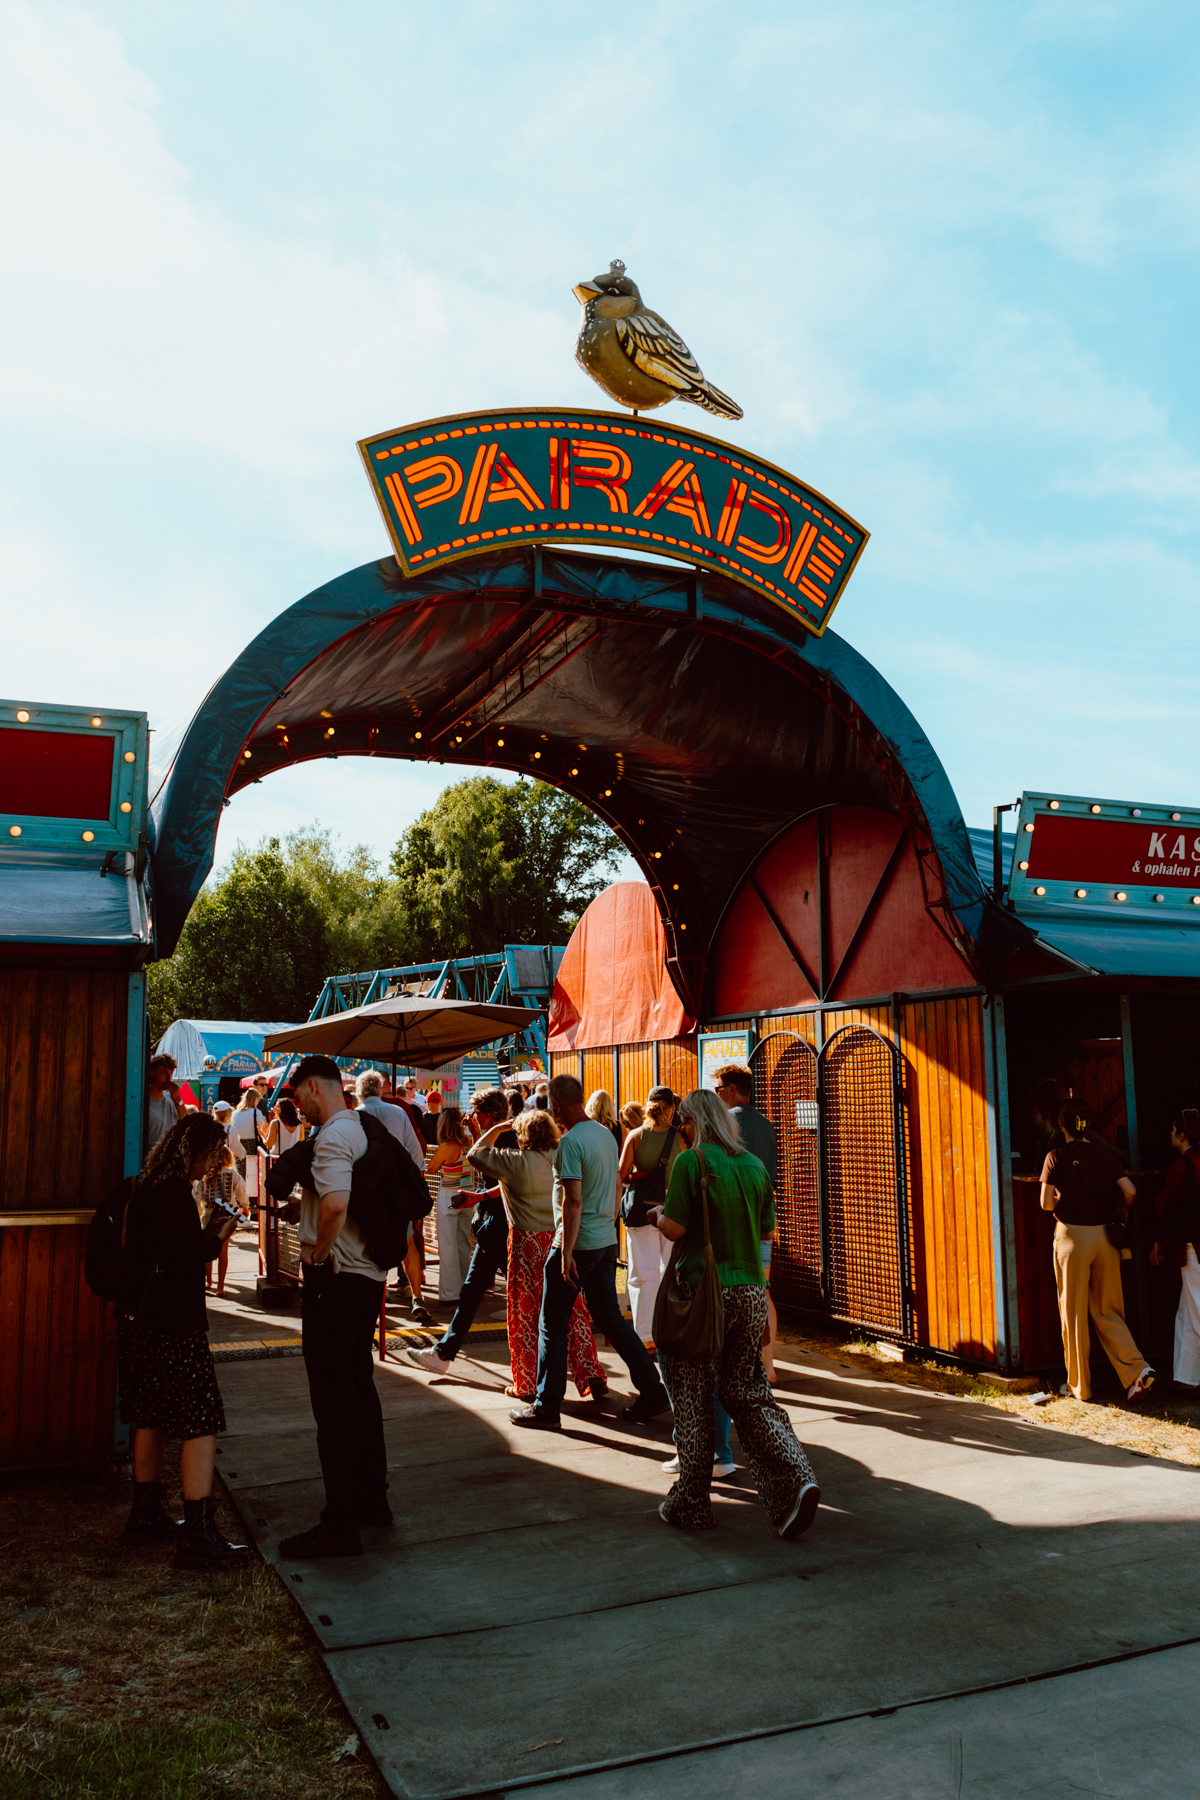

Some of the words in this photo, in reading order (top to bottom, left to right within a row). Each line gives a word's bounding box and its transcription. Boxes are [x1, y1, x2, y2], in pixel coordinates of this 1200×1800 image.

[384, 437, 846, 608] PARADE
[1144, 862, 1190, 876] ophalen
[704, 1040, 746, 1058] PARADE
[228, 1059, 257, 1068] PARADE
